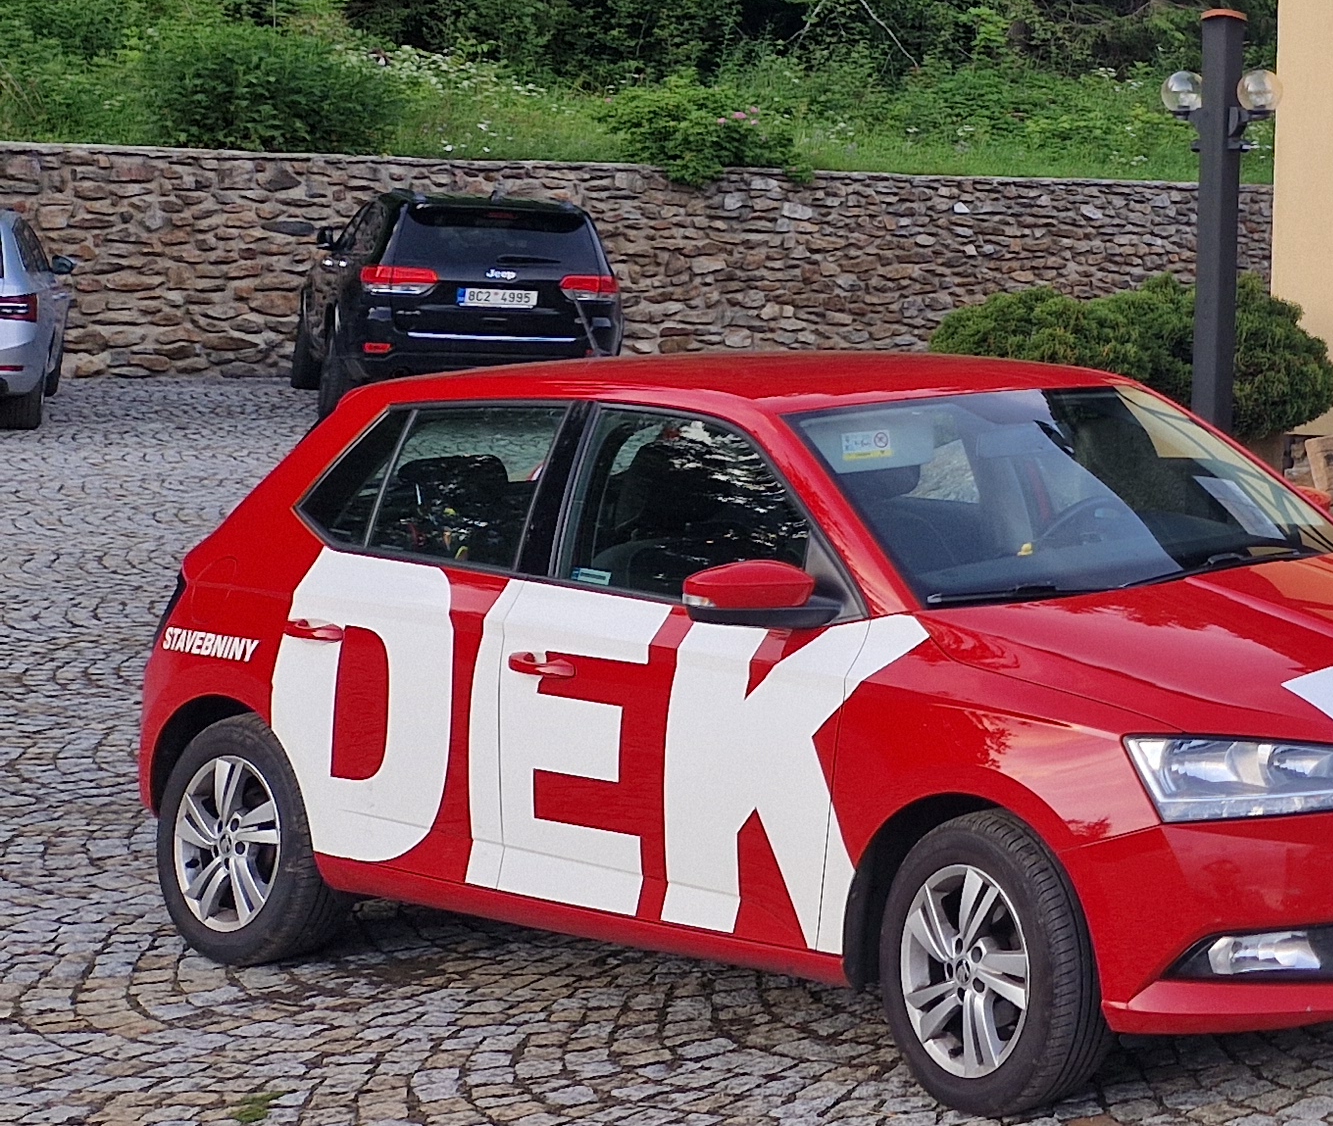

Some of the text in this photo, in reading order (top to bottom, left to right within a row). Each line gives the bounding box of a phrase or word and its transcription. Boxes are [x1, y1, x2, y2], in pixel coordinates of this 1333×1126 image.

[486, 269, 517, 280] Jeep
[468, 290, 531, 303] 8C2 4995
[163, 626, 259, 662] STAVEBNINY
[270, 547, 929, 955] DEK
